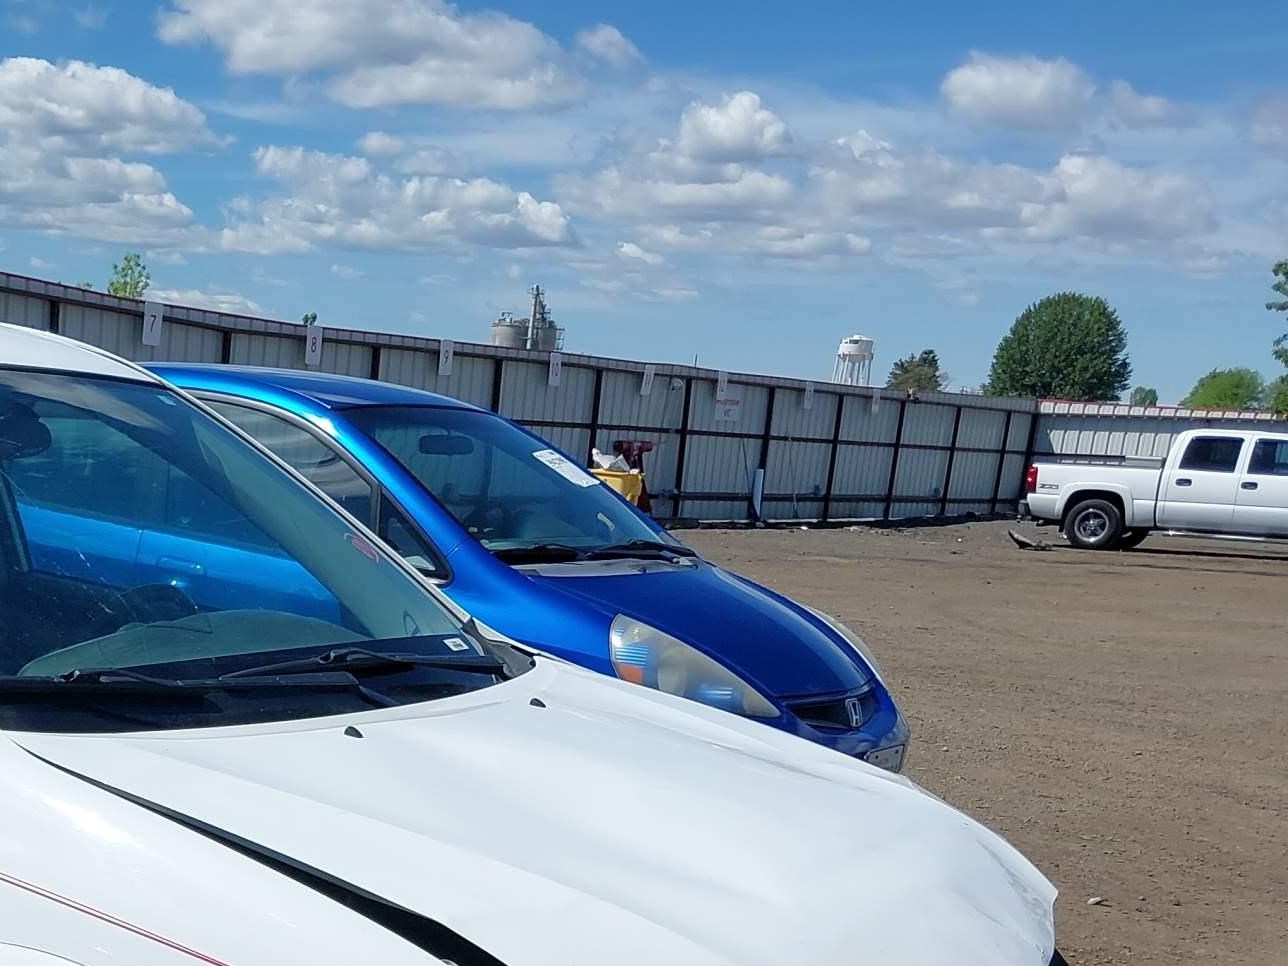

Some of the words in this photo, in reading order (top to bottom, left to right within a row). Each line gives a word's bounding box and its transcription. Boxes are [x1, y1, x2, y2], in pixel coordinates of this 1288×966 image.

[150, 314, 158, 333] 7
[310, 336, 318, 353] 8
[443, 349, 450, 365] 9
